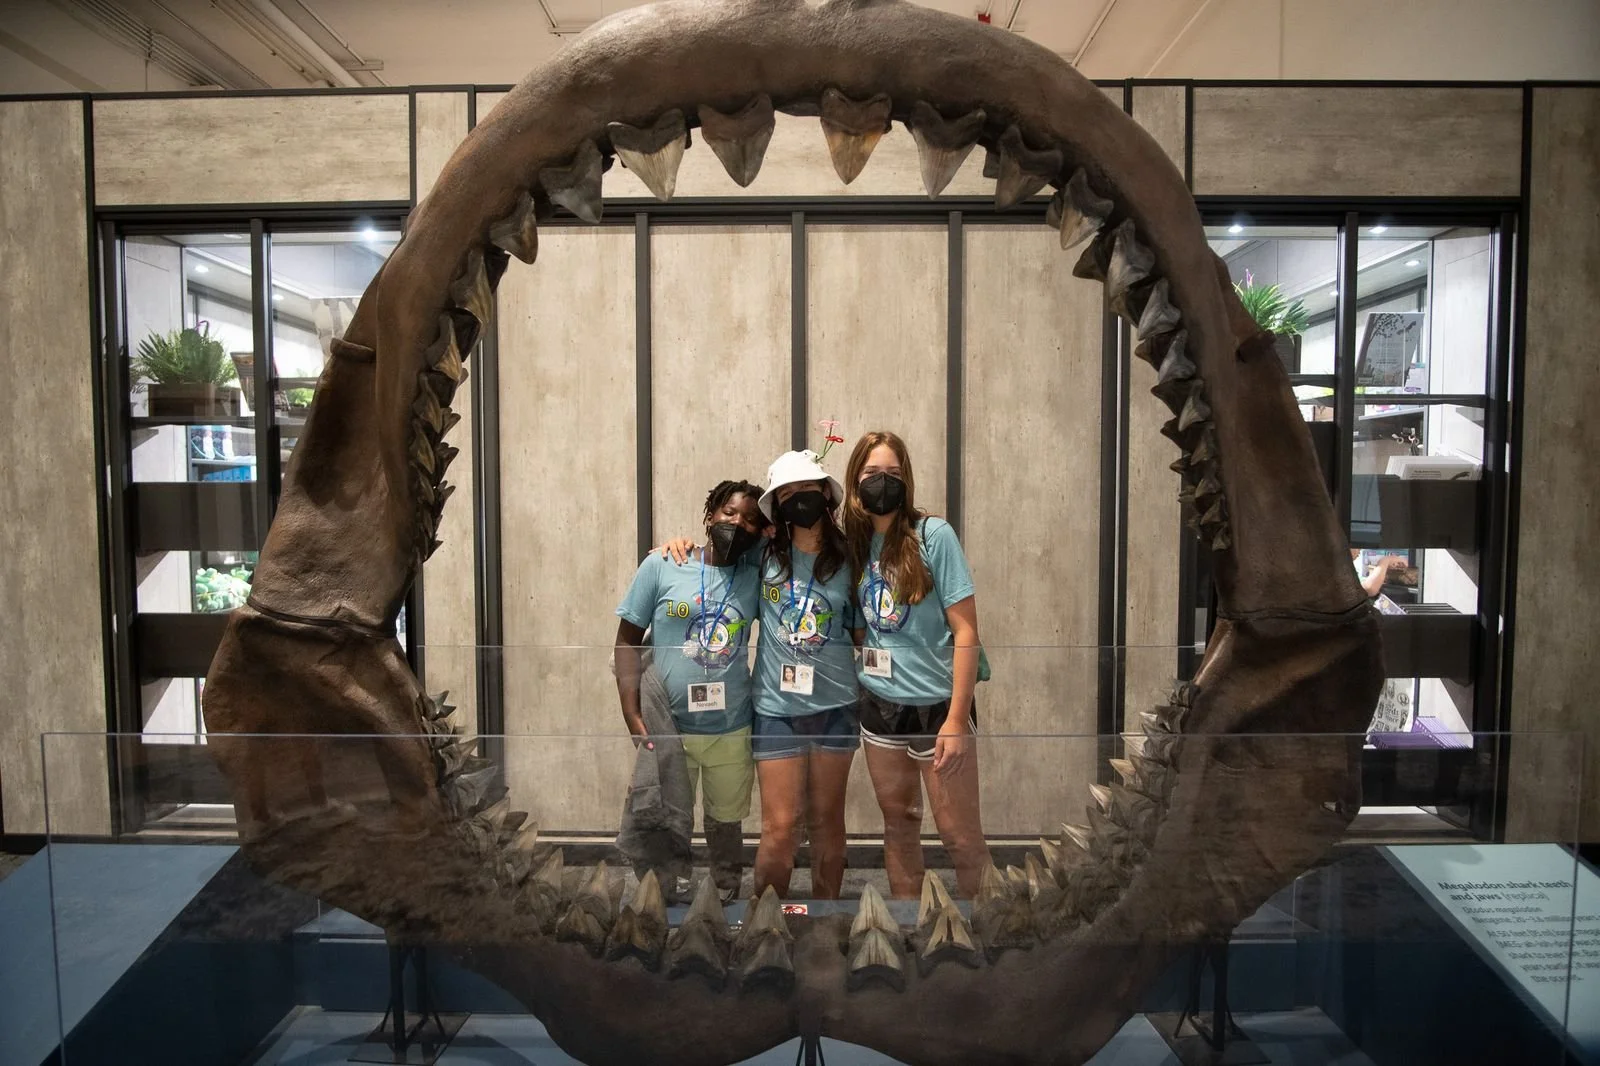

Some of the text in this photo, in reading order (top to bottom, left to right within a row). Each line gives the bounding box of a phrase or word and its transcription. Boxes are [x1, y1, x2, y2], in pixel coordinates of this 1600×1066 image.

[762, 584, 780, 603] 10
[666, 600, 689, 618] 10
[1438, 880, 1574, 891] Megalodon shark teeth
[1450, 891, 1550, 901] and jaws (replica)
[1495, 906, 1543, 914] megalodon
